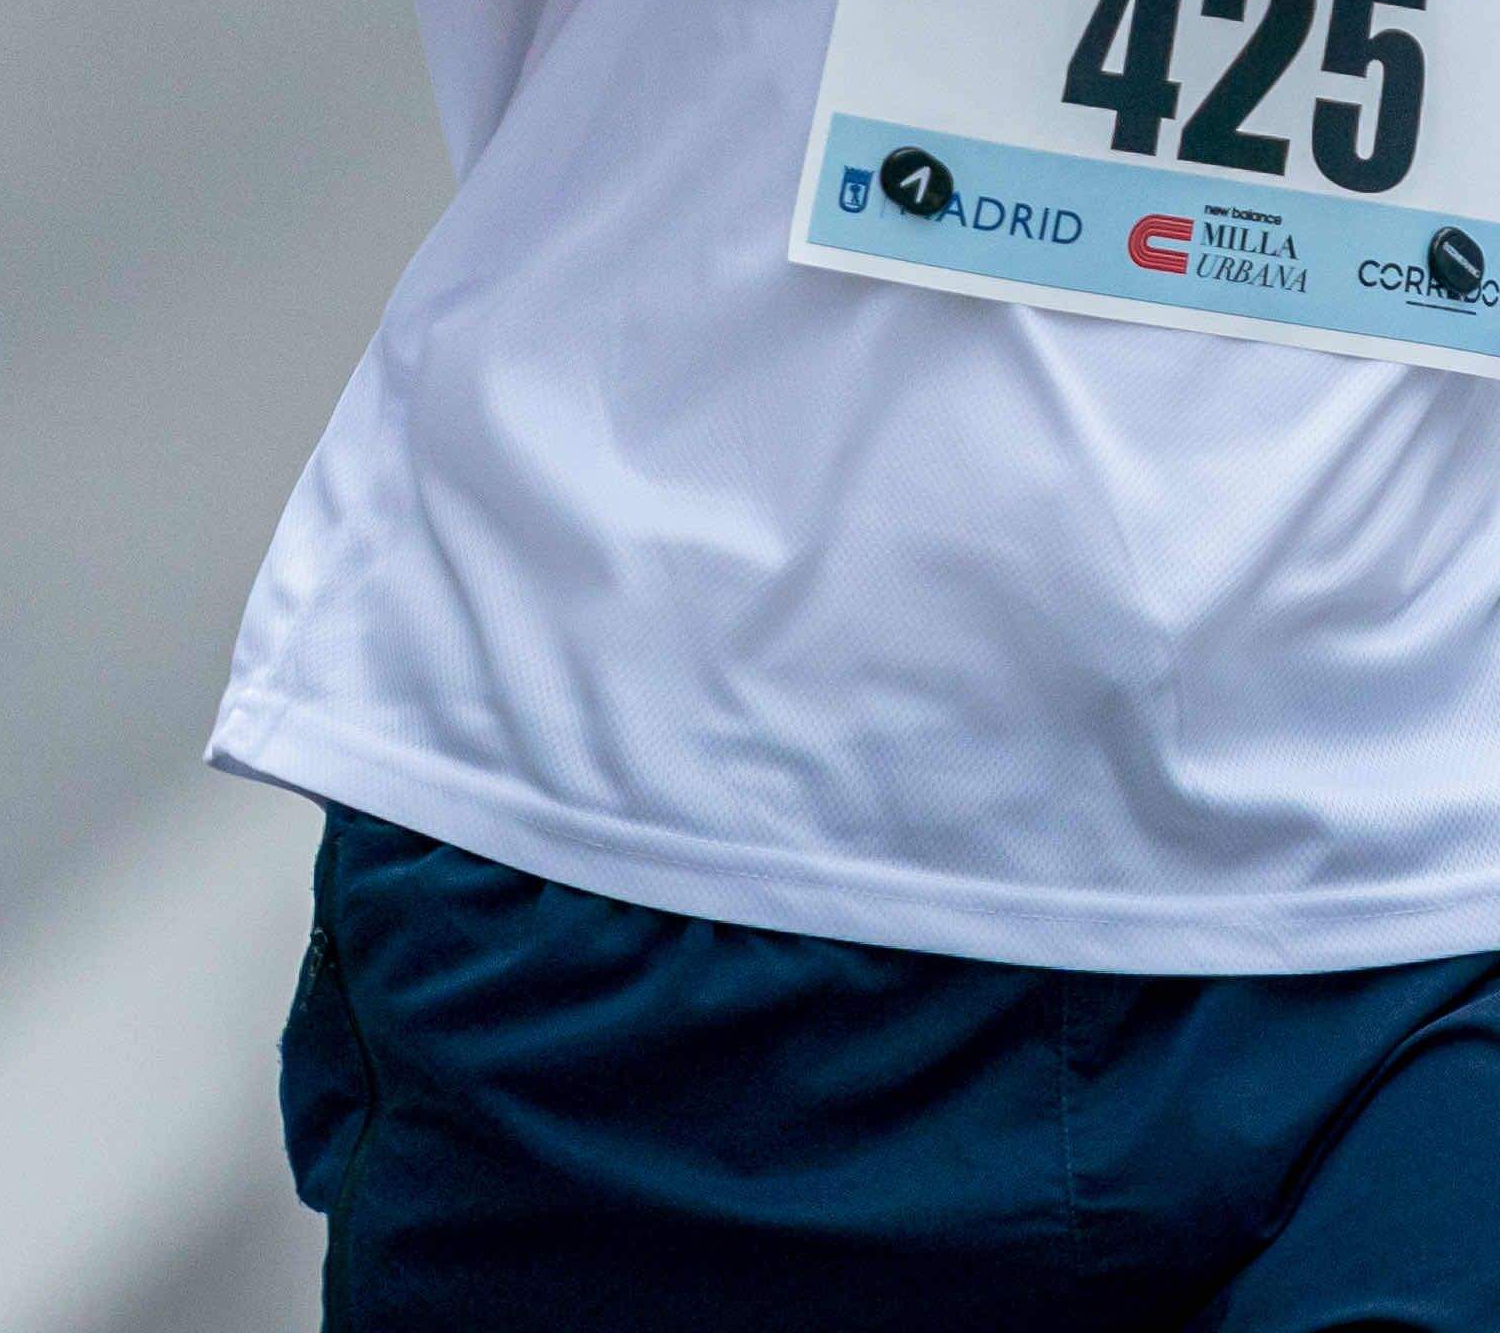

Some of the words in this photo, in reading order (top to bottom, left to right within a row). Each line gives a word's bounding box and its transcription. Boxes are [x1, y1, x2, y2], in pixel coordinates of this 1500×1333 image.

[900, 190, 1083, 245] ADRID
[1203, 204, 1229, 217] new
[1231, 207, 1283, 226] balance
[1200, 221, 1301, 261] MILLA
[1196, 252, 1309, 294] URBANA
